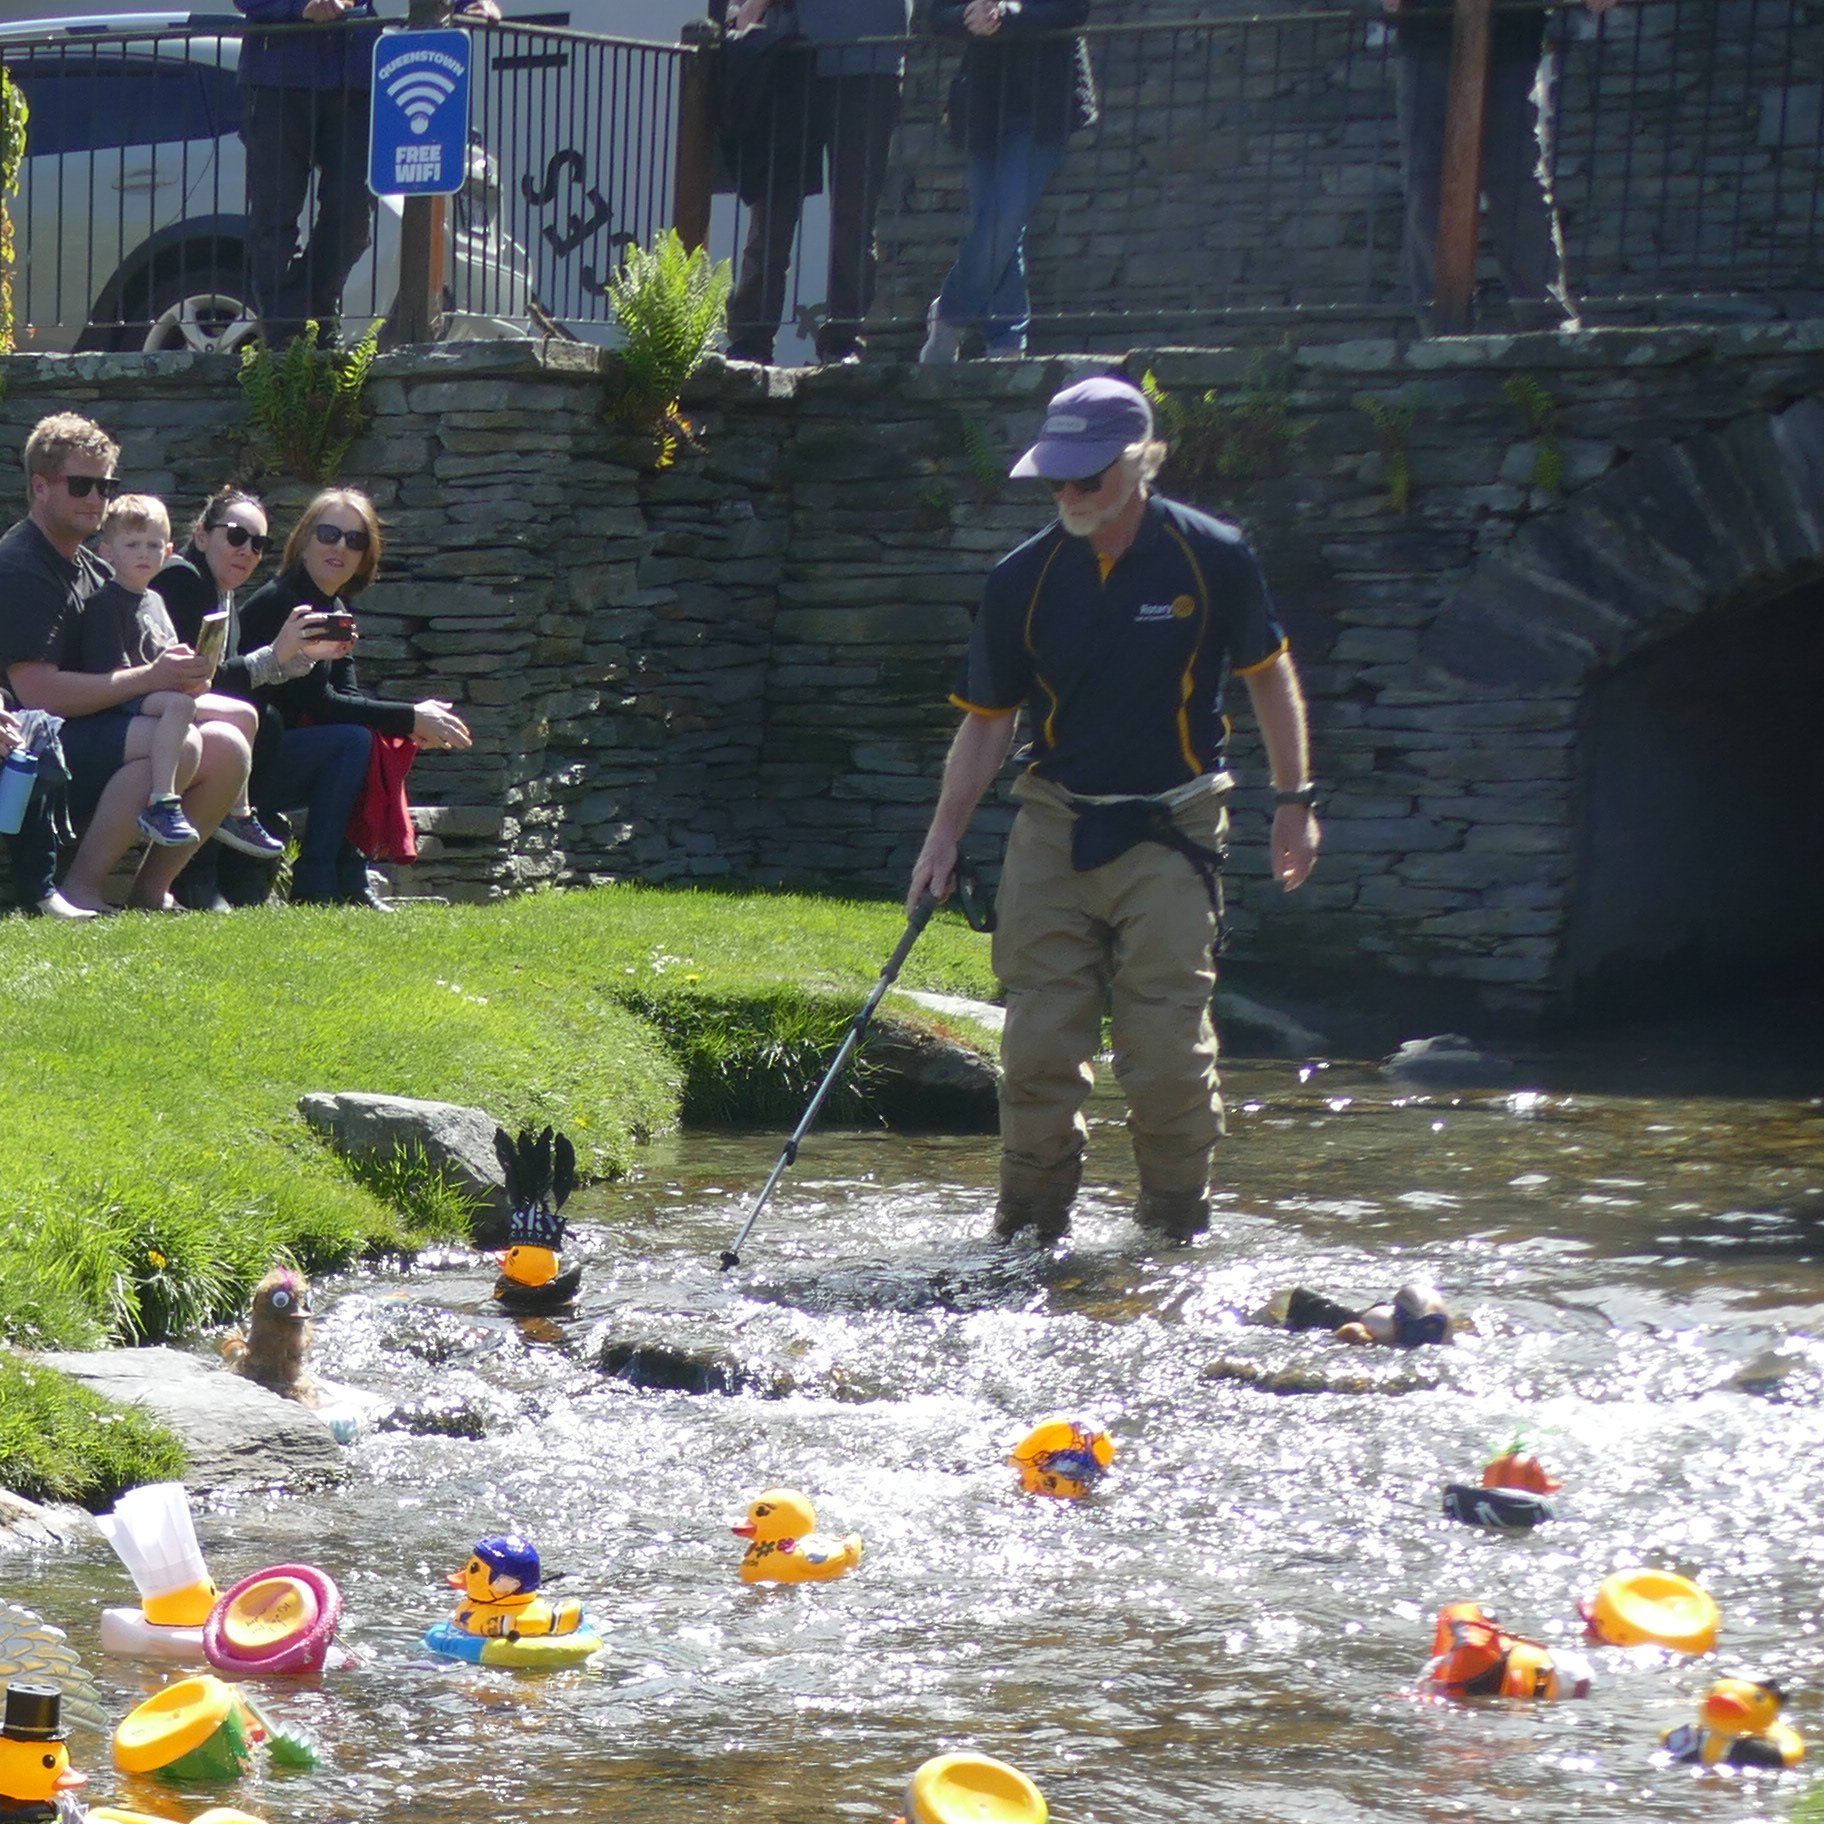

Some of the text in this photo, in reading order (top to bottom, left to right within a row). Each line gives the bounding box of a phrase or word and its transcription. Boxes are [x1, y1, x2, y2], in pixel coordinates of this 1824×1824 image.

[378, 50, 466, 80] QUEENSTOWN
[396, 144, 442, 163] FREE
[395, 162, 441, 184] WIFI
